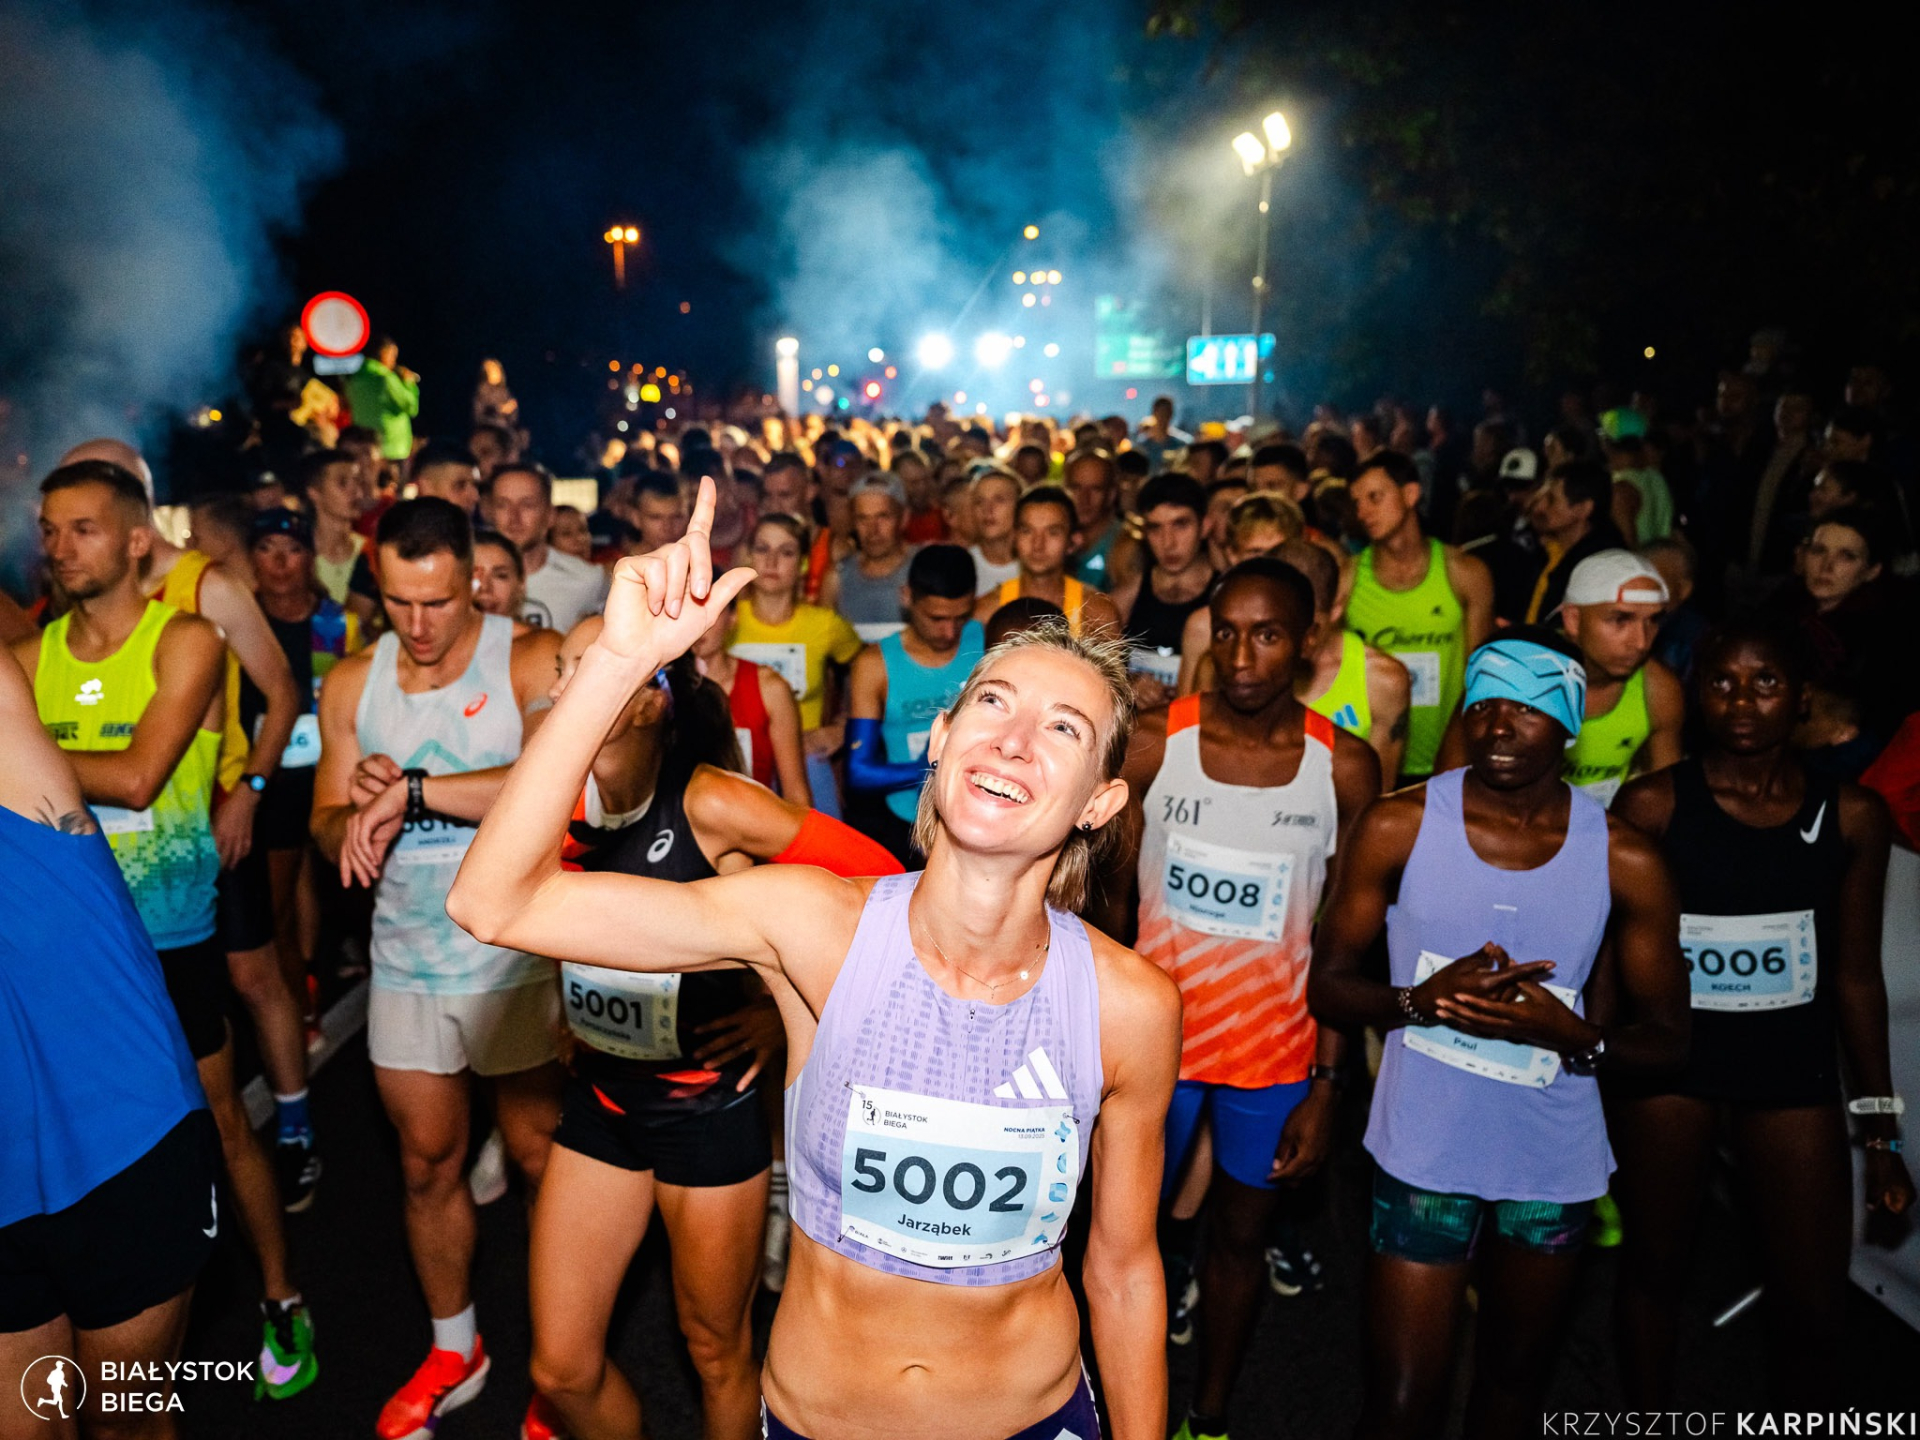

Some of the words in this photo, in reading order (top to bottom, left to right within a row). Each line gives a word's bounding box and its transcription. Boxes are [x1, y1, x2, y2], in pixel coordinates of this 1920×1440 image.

[1167, 864, 1260, 908] 5008
[569, 980, 642, 1029] 5001
[1453, 1036, 1477, 1051] Paul
[862, 1100, 873, 1110] 15
[883, 1119, 907, 1129] BIEGA
[885, 1110, 928, 1123] BIAŁYSTOK
[851, 1147, 1027, 1212] 5002
[898, 1213, 971, 1237] Jarząbek
